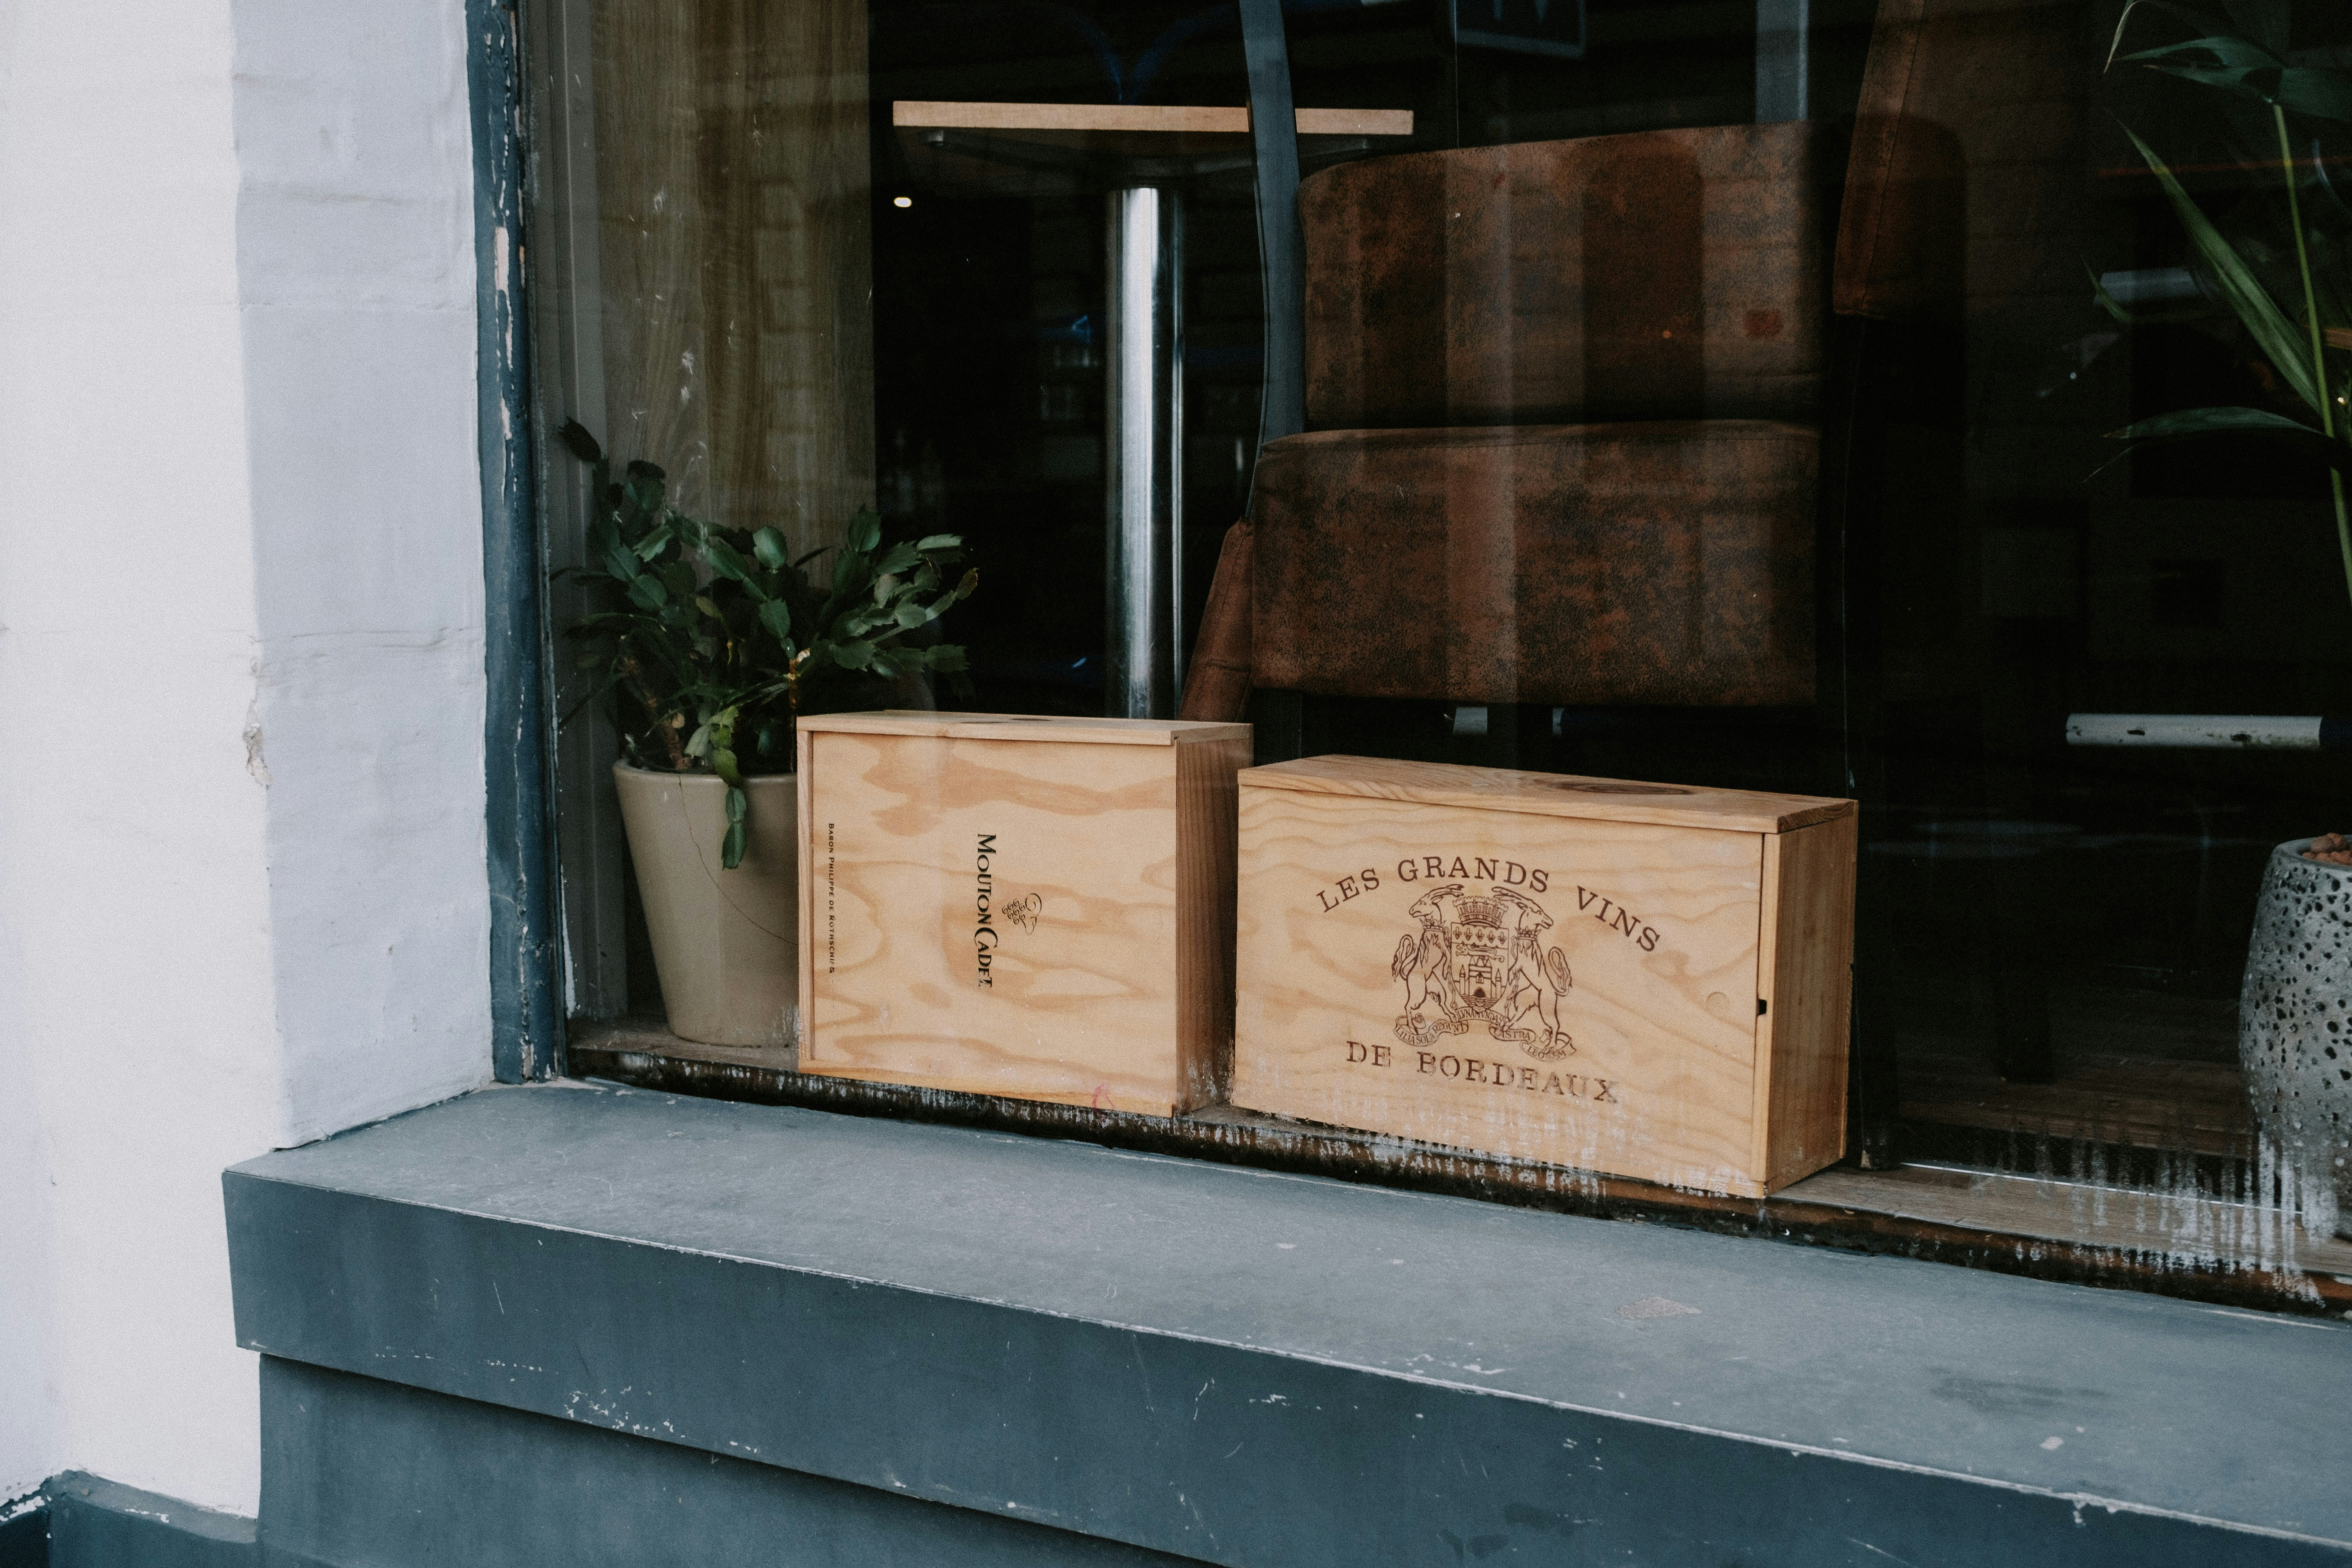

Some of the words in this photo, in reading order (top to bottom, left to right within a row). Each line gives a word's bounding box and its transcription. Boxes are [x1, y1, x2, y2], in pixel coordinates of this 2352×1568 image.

[829, 900, 834, 911] DE
[1316, 867, 1380, 913] LES
[1398, 856, 1549, 893] GRANDS
[1576, 885, 1661, 952] VINS
[1346, 1041, 1391, 1068] DE
[1416, 1051, 1619, 1103] BORDEAUX
